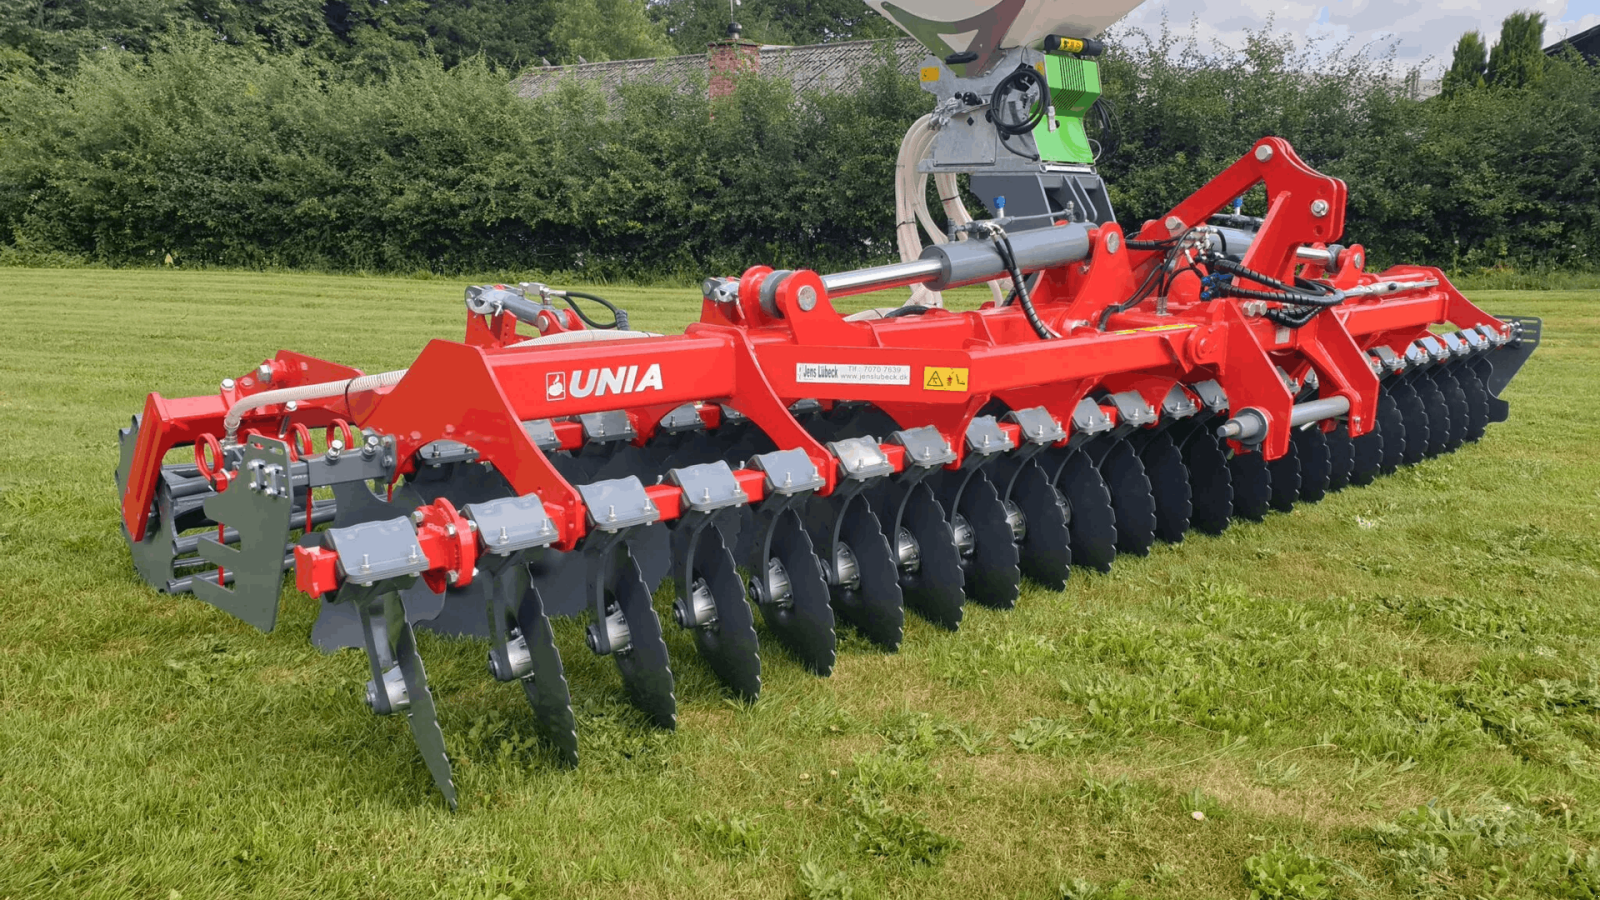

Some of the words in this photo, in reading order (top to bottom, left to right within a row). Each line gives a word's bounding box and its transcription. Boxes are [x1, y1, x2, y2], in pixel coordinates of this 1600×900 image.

[569, 363, 663, 398] UNIA
[803, 365, 817, 378] Jens
[818, 365, 838, 378] Lübeck
